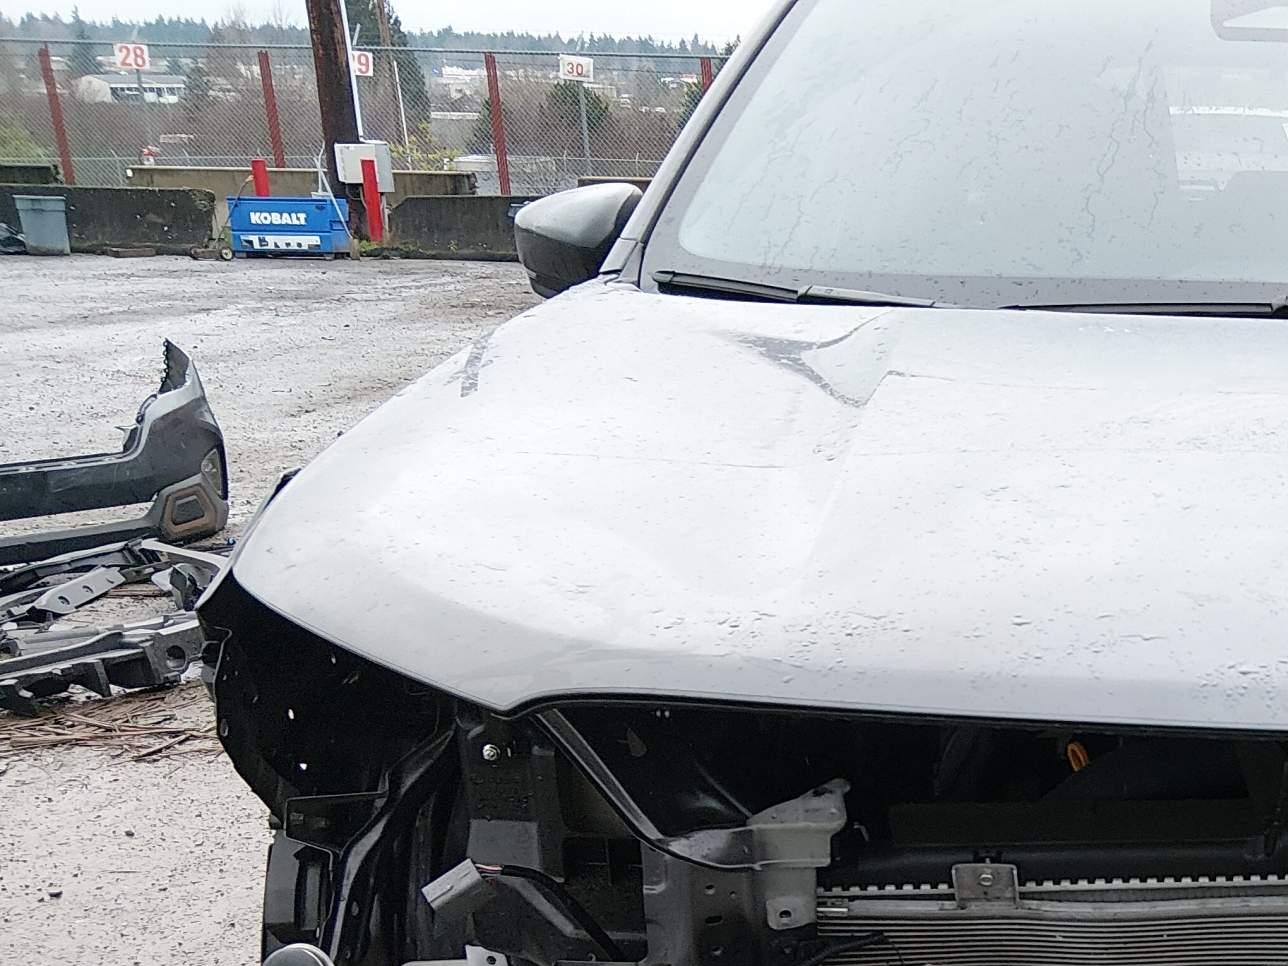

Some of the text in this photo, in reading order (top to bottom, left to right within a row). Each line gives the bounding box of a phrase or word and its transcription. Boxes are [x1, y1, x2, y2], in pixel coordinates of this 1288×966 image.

[119, 45, 146, 68] 28
[352, 52, 370, 75] 9
[566, 62, 584, 76] 30
[249, 212, 307, 225] KOBALT
